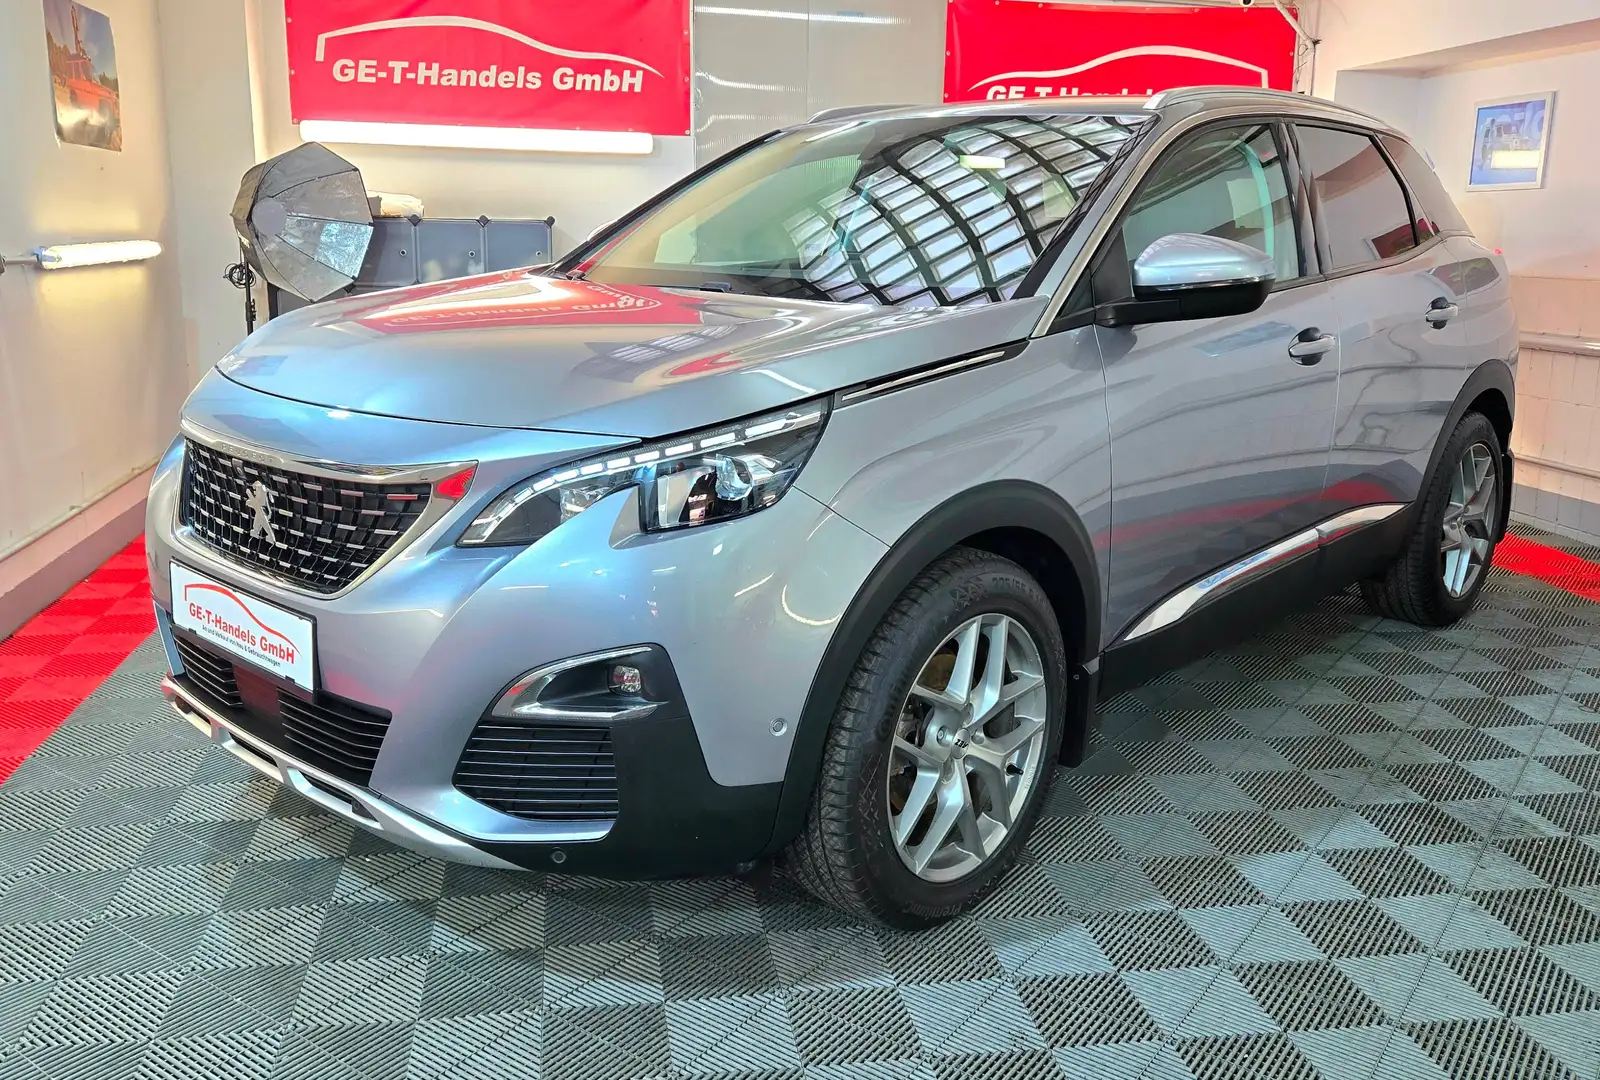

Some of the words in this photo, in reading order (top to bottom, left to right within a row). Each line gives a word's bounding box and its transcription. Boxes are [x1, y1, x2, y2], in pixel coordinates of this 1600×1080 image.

[332, 58, 542, 89] GE-T-Handels
[552, 67, 643, 93] GmbH
[189, 602, 257, 646] GE-T-Handels
[260, 635, 295, 664] GmbH
